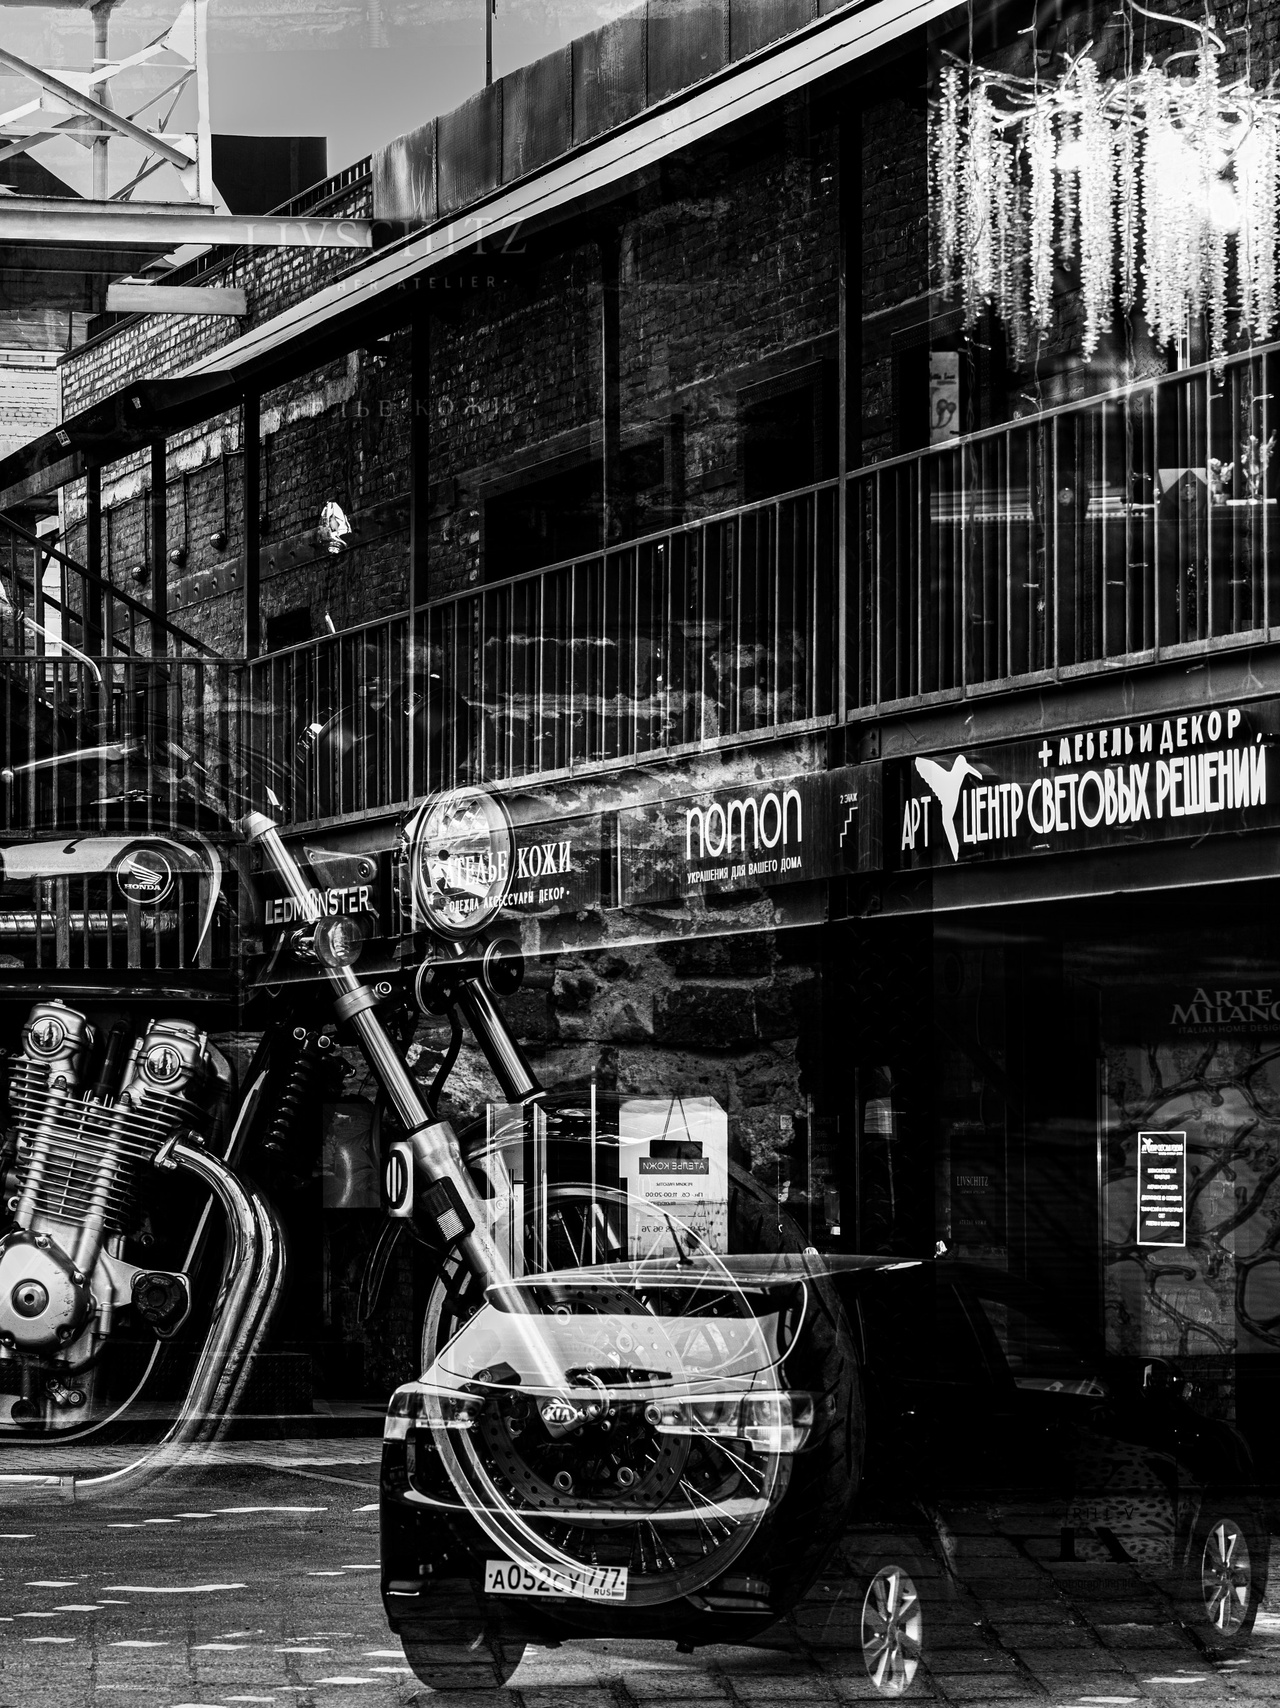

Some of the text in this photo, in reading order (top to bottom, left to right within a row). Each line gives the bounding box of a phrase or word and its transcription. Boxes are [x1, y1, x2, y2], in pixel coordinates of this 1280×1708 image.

[1058, 726, 1134, 766] МЕБЕЛЬ
[1140, 723, 1152, 751] И
[1160, 708, 1241, 754] ДЕКОР
[902, 732, 1267, 850] АРТ ЦЕНТР СВЕТОВЫХ РЕШЕНИЙ
[686, 789, 803, 860] nomon
[517, 841, 572, 879] КОЖИ
[687, 856, 803, 885] УКРАШЕНИЯ ДЛЯ ВАШЕГО ДОМА
[124, 883, 161, 891] HONDA
[539, 886, 565, 904] ДЕКОР
[1192, 988, 1273, 1009] ARTE
[1179, 1024, 1280, 1034] ITALIAN HOME DESIG
[956, 1176, 989, 1187] LIVSCHITZ
[593, 1587, 612, 1597] RUS
